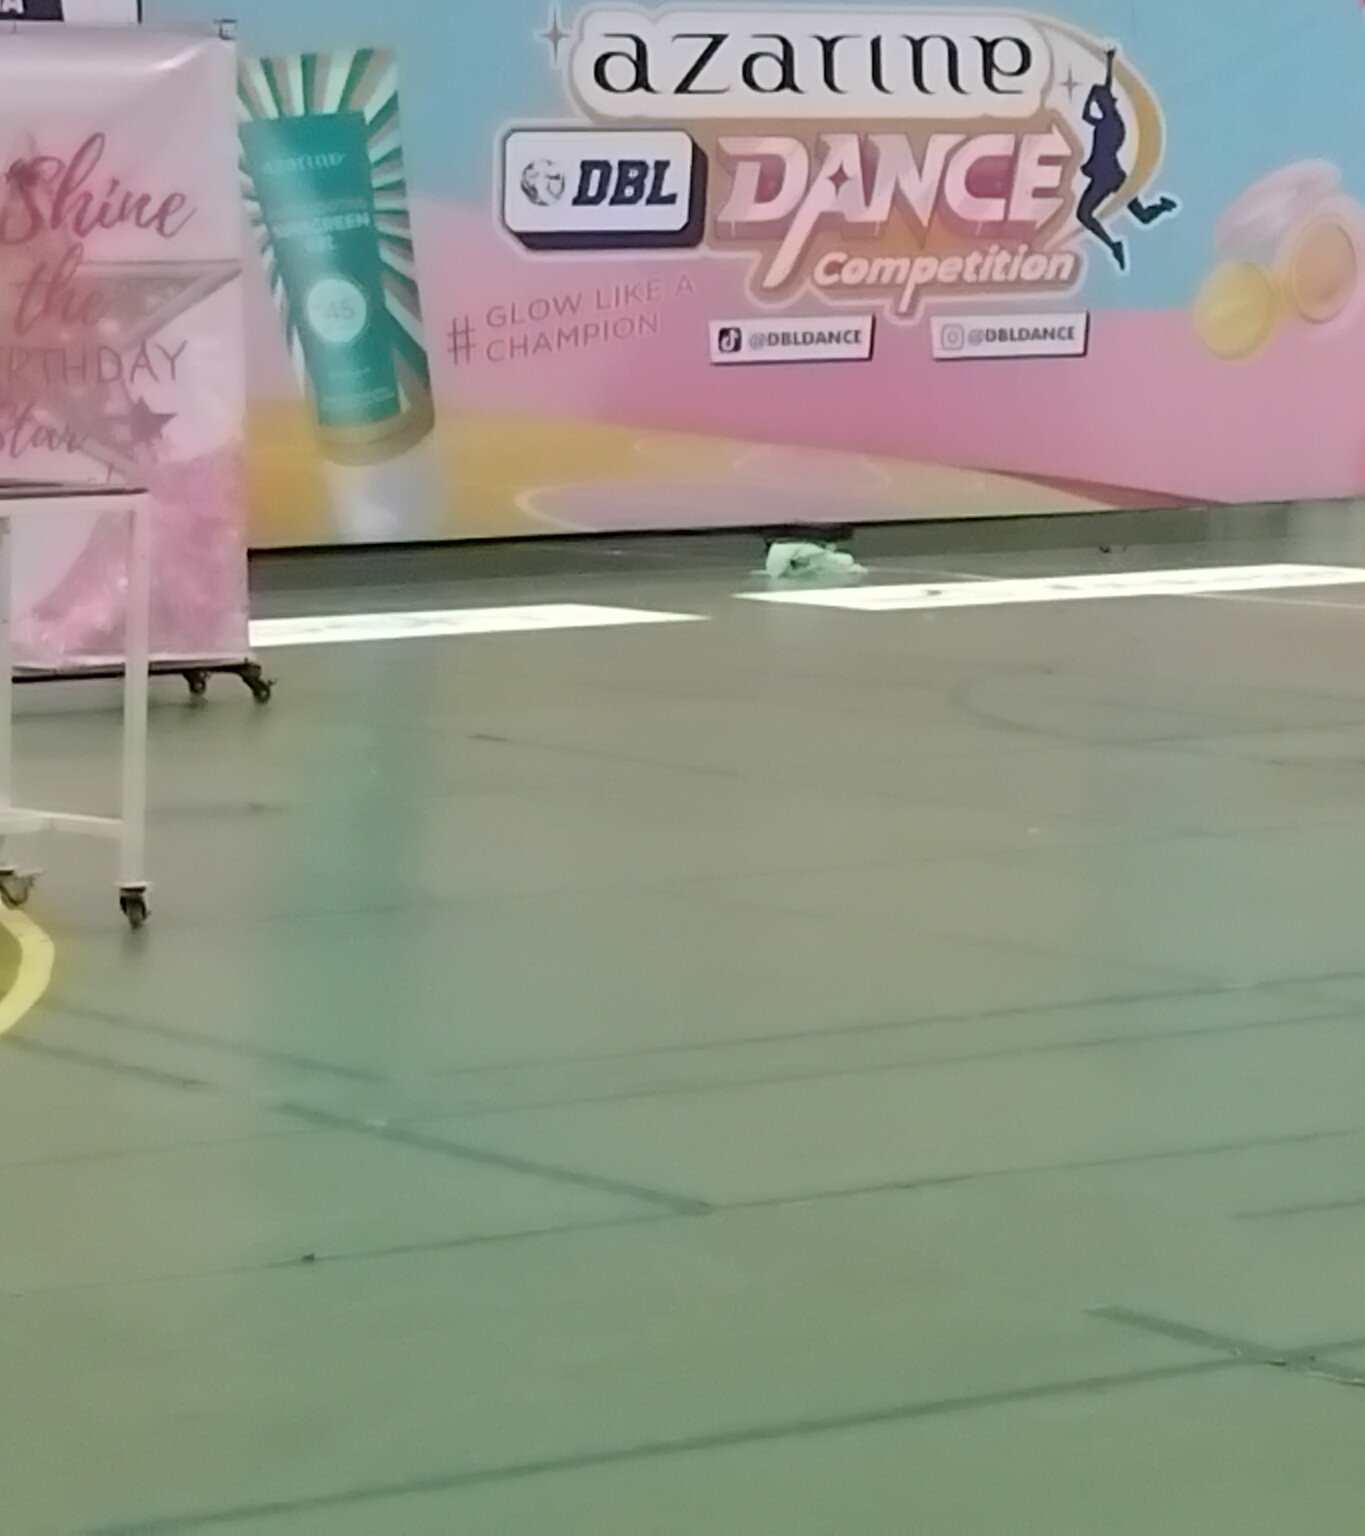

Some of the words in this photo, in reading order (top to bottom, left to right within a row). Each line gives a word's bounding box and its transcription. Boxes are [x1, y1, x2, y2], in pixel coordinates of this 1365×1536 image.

[592, 31, 1035, 95] azarine
[2, 132, 197, 244] Shine
[573, 159, 678, 207] DBL
[716, 124, 1075, 288] DANCE
[486, 292, 583, 329] GLOW
[595, 278, 662, 310] LIKE
[675, 274, 695, 296] A
[813, 244, 1076, 313] Competition
[6, 339, 188, 386] RTHDAY
[486, 314, 658, 362] CHAMPION
[749, 329, 862, 351] @DBLDANCE
[968, 325, 1075, 345] @DBLDANCE
